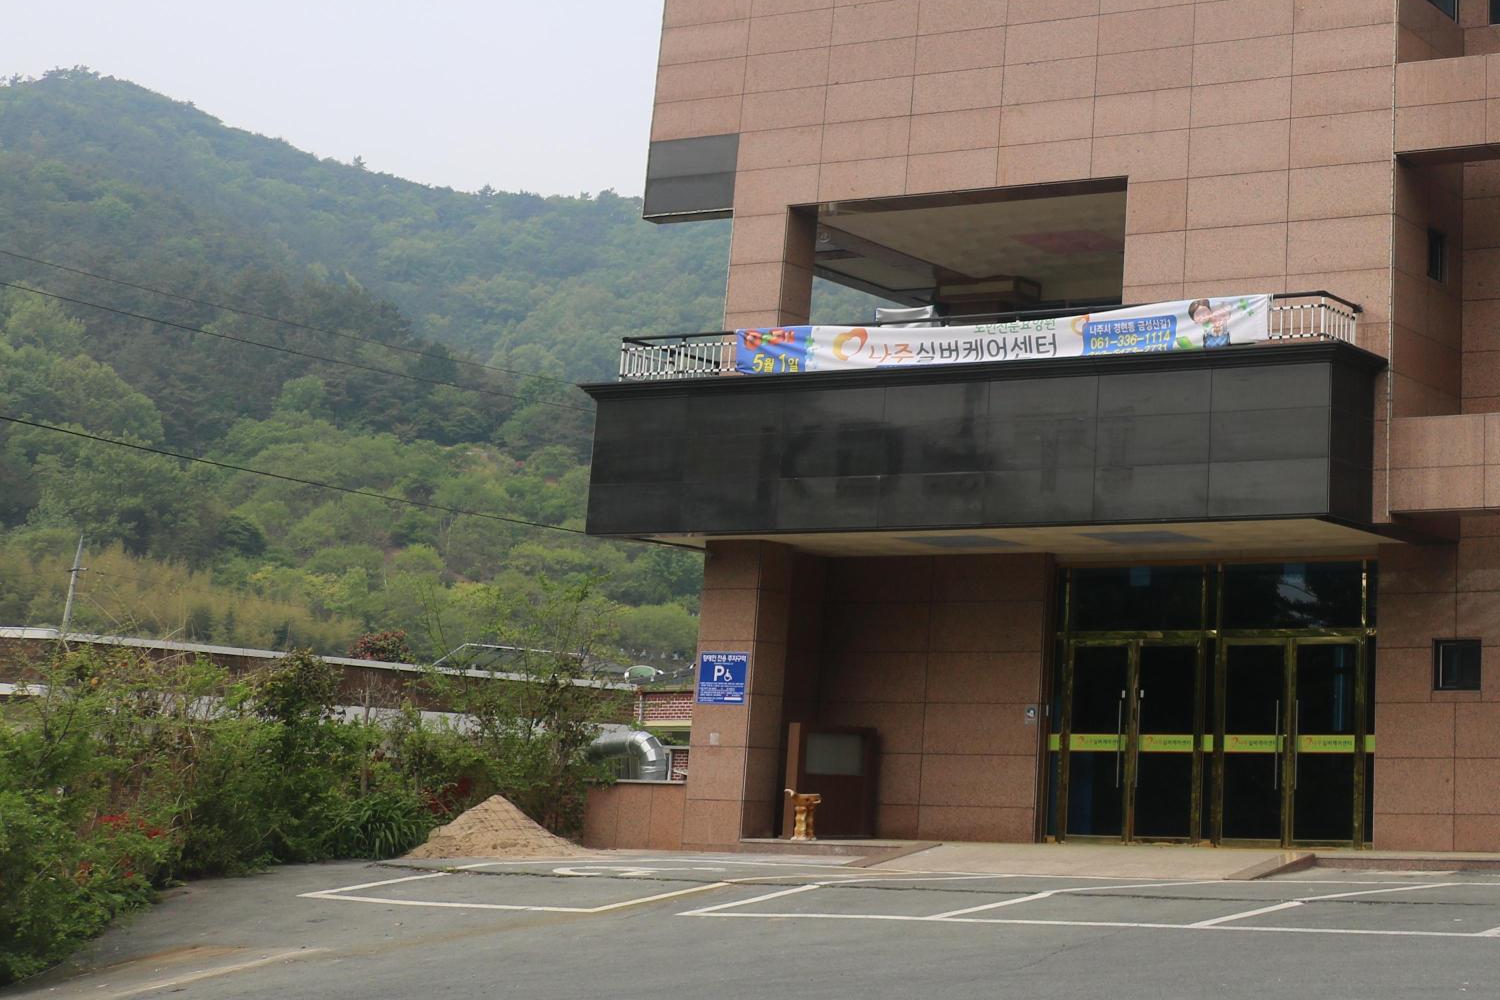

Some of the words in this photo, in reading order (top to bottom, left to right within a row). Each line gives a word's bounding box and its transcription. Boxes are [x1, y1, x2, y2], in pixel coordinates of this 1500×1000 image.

[1090, 330, 1170, 350] 061-336-1114
[752, 353, 775, 373] 5월
[778, 353, 799, 373] 1일
[714, 665, 725, 681] P
